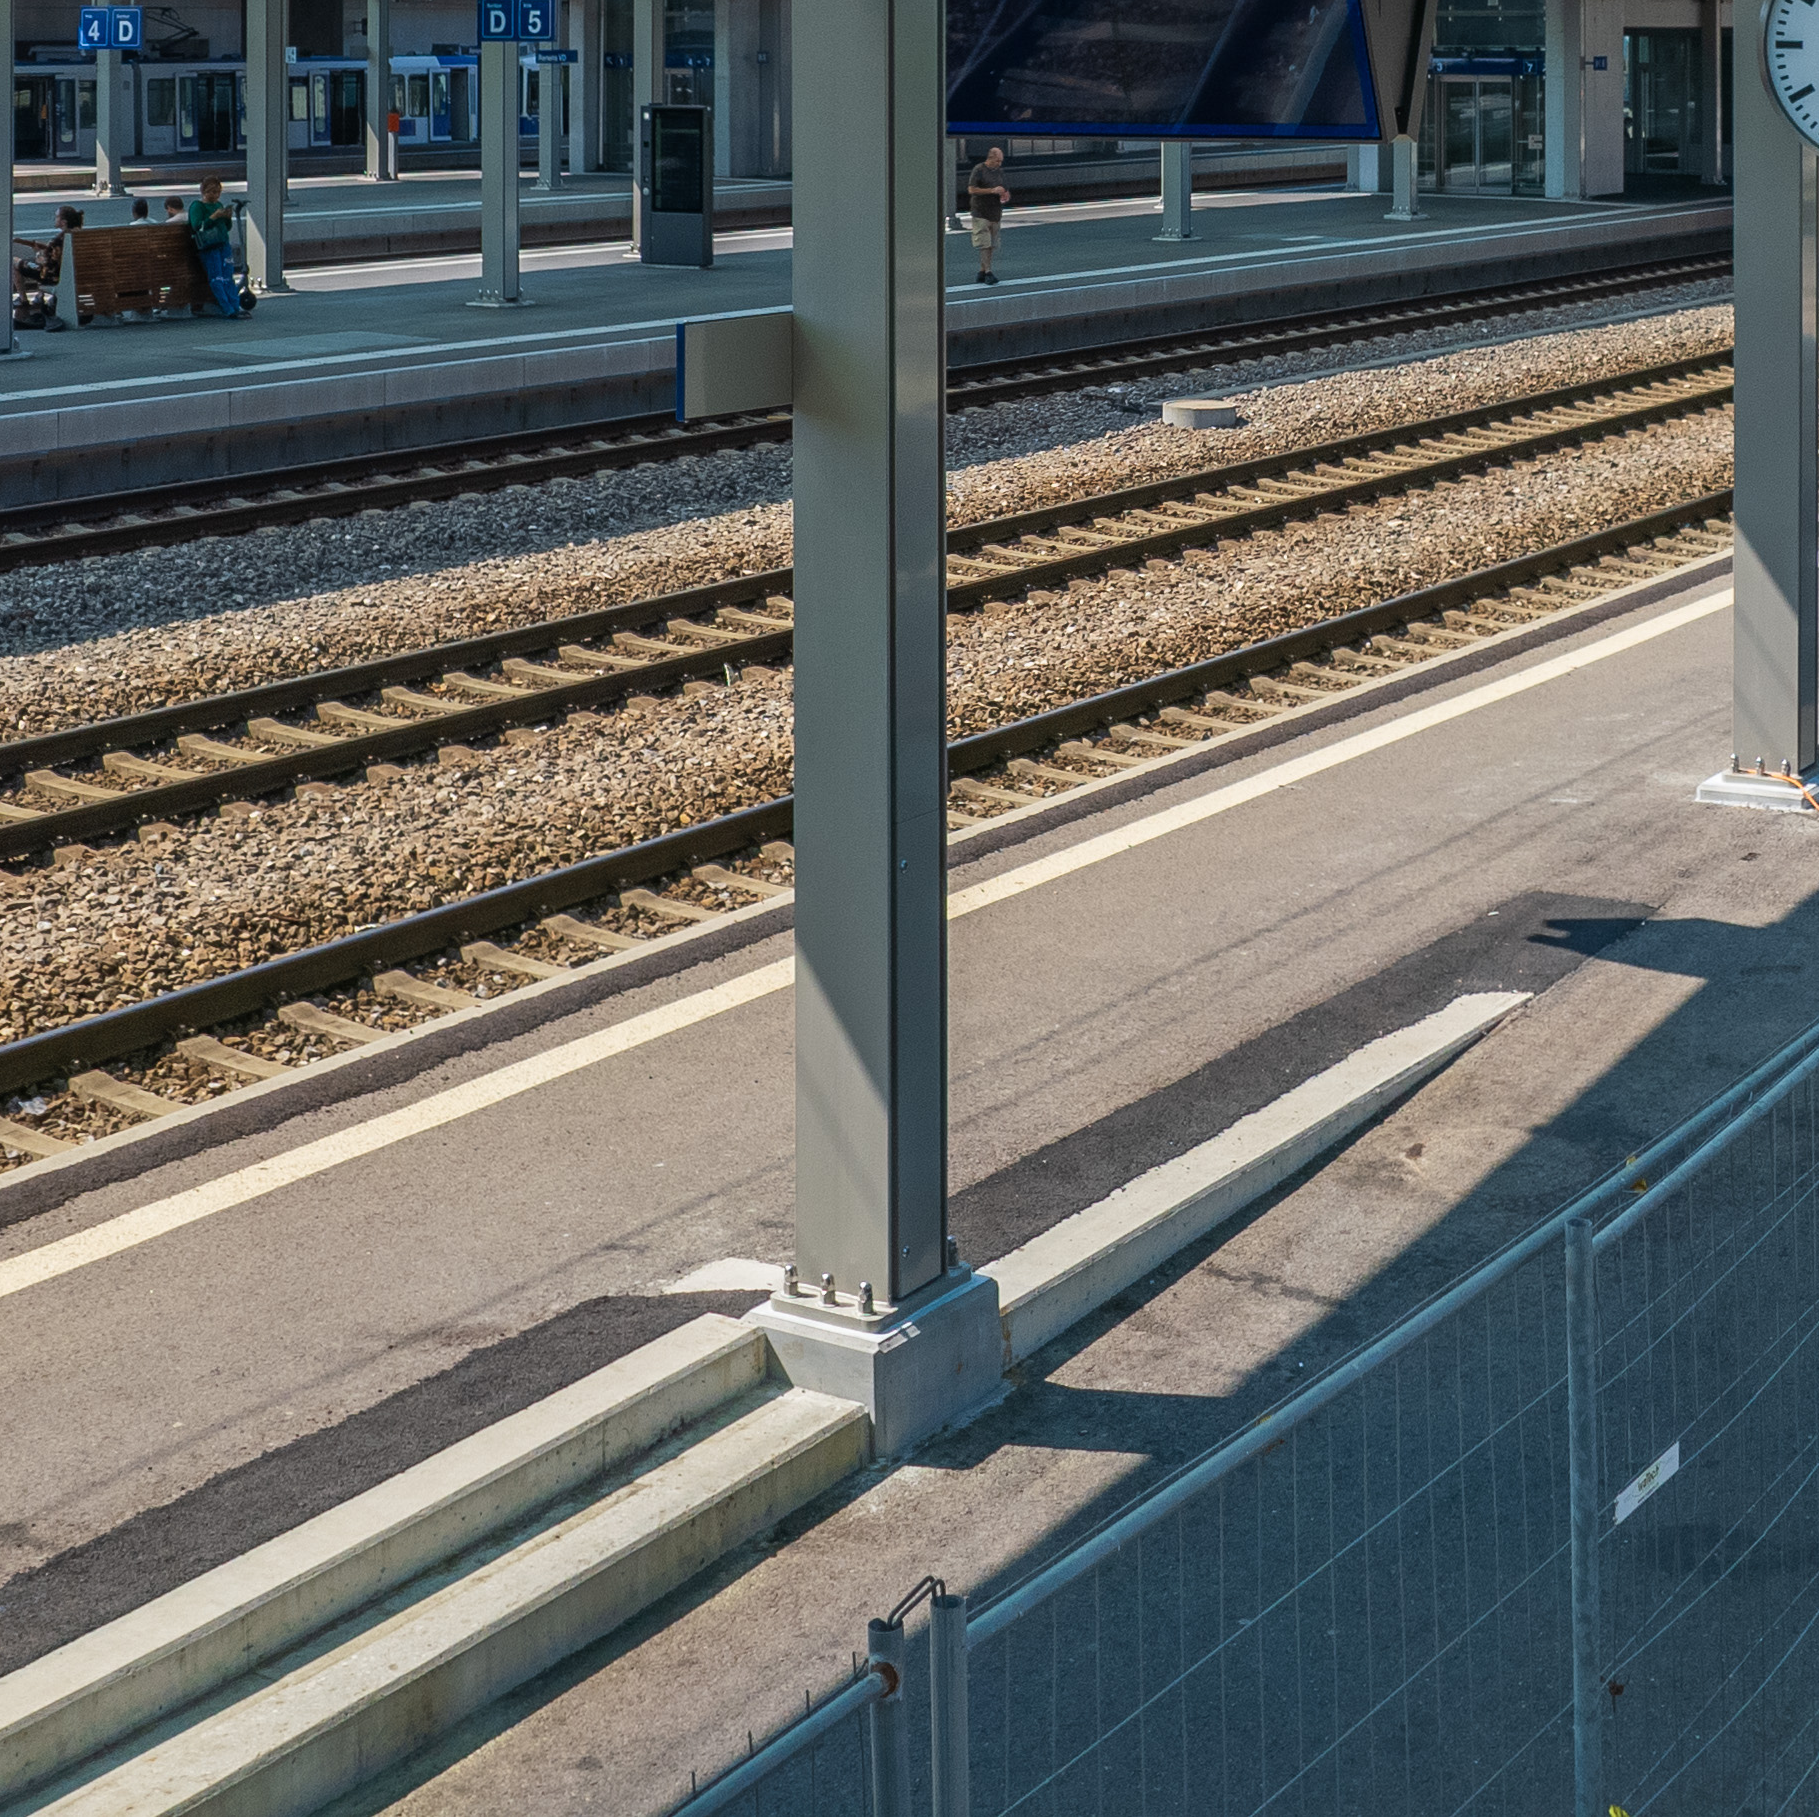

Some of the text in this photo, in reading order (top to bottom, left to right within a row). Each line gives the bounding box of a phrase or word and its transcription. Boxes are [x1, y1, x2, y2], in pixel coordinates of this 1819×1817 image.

[87, 20, 133, 41] 4 D
[489, 10, 542, 34] D 5
